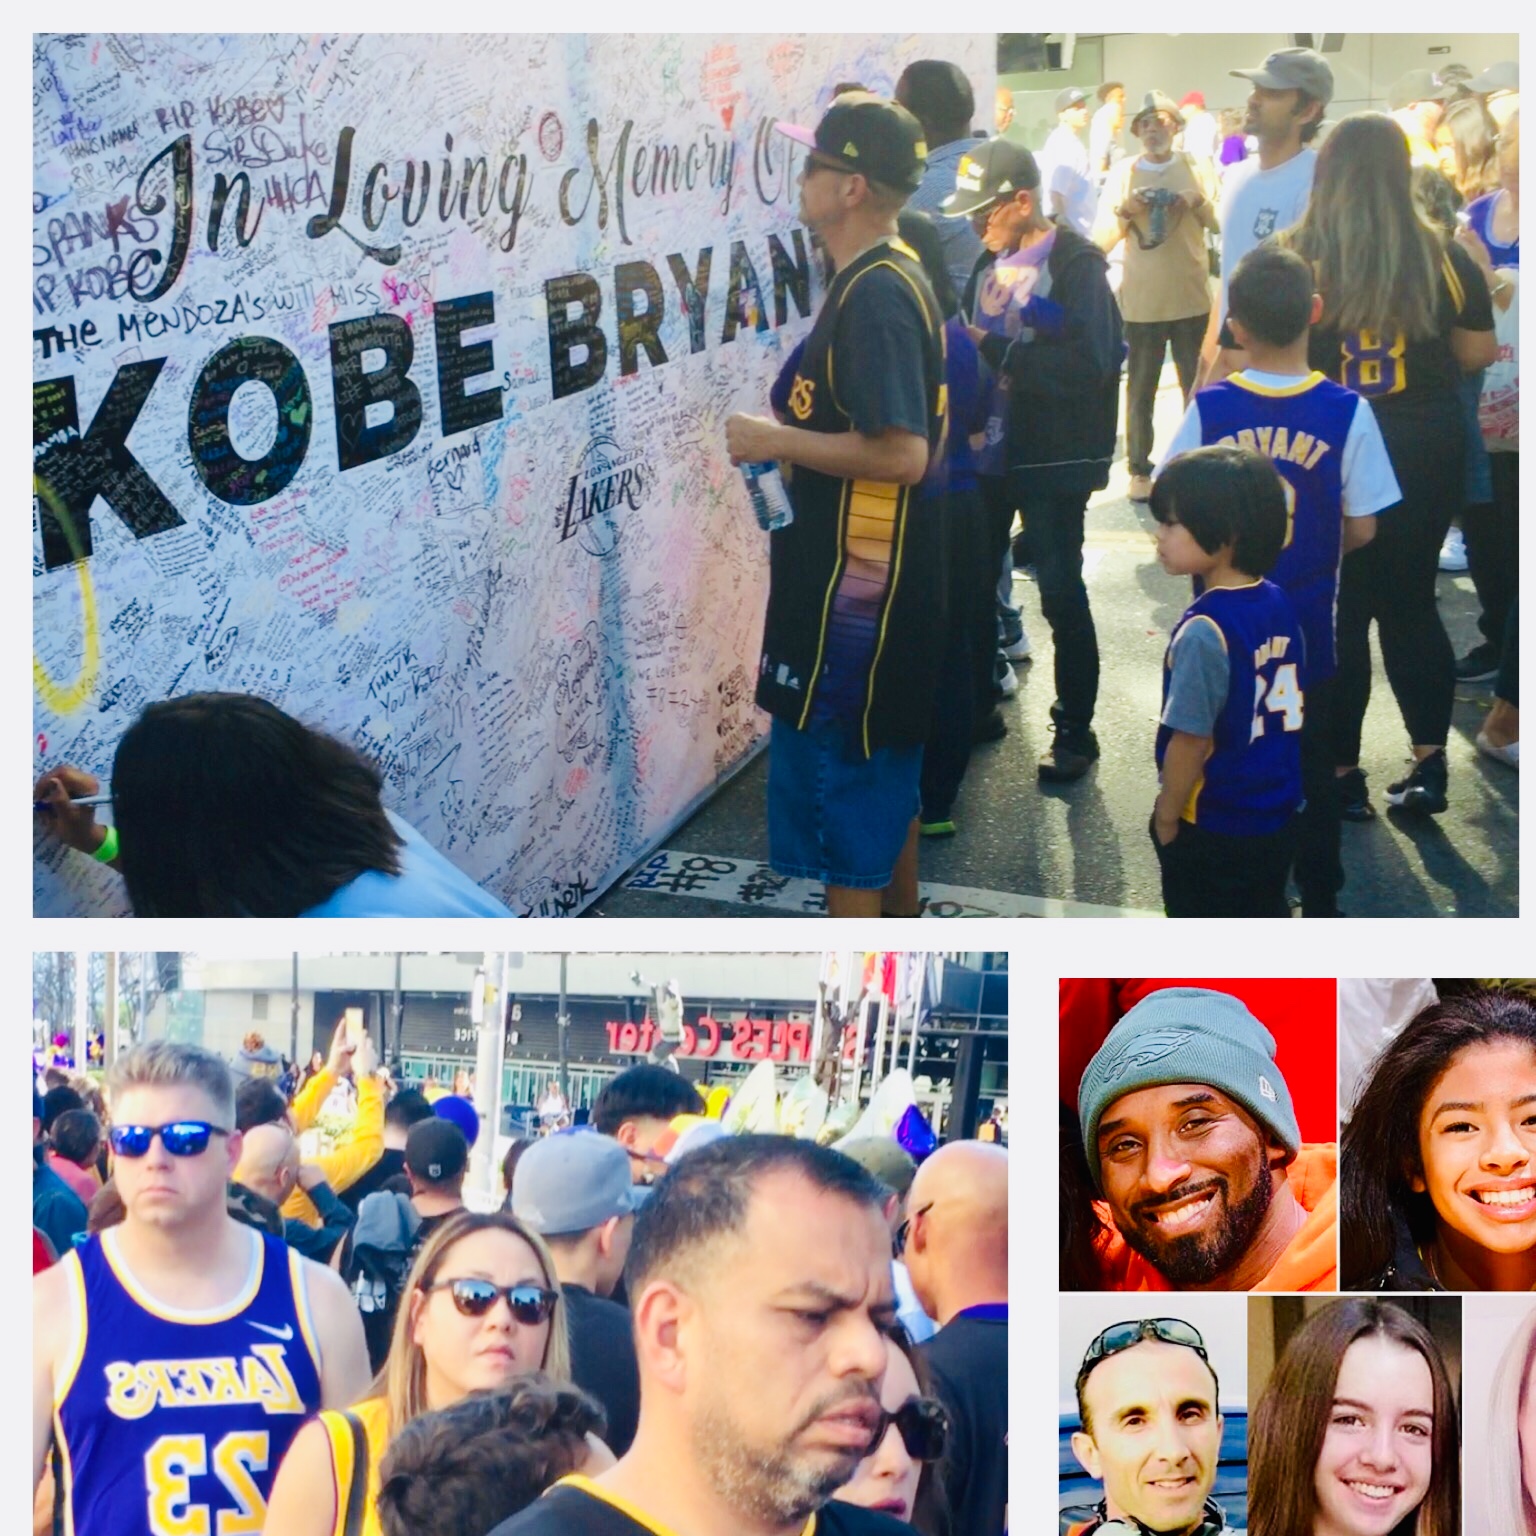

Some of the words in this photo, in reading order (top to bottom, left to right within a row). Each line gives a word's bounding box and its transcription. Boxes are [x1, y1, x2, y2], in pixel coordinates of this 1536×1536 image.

[128, 133, 265, 303] In
[306, 126, 533, 266] Loving
[559, 118, 735, 246] Memory
[33, 291, 504, 570] KOBE
[556, 462, 645, 545] LAKERS
[626, 853, 670, 889] RIP
